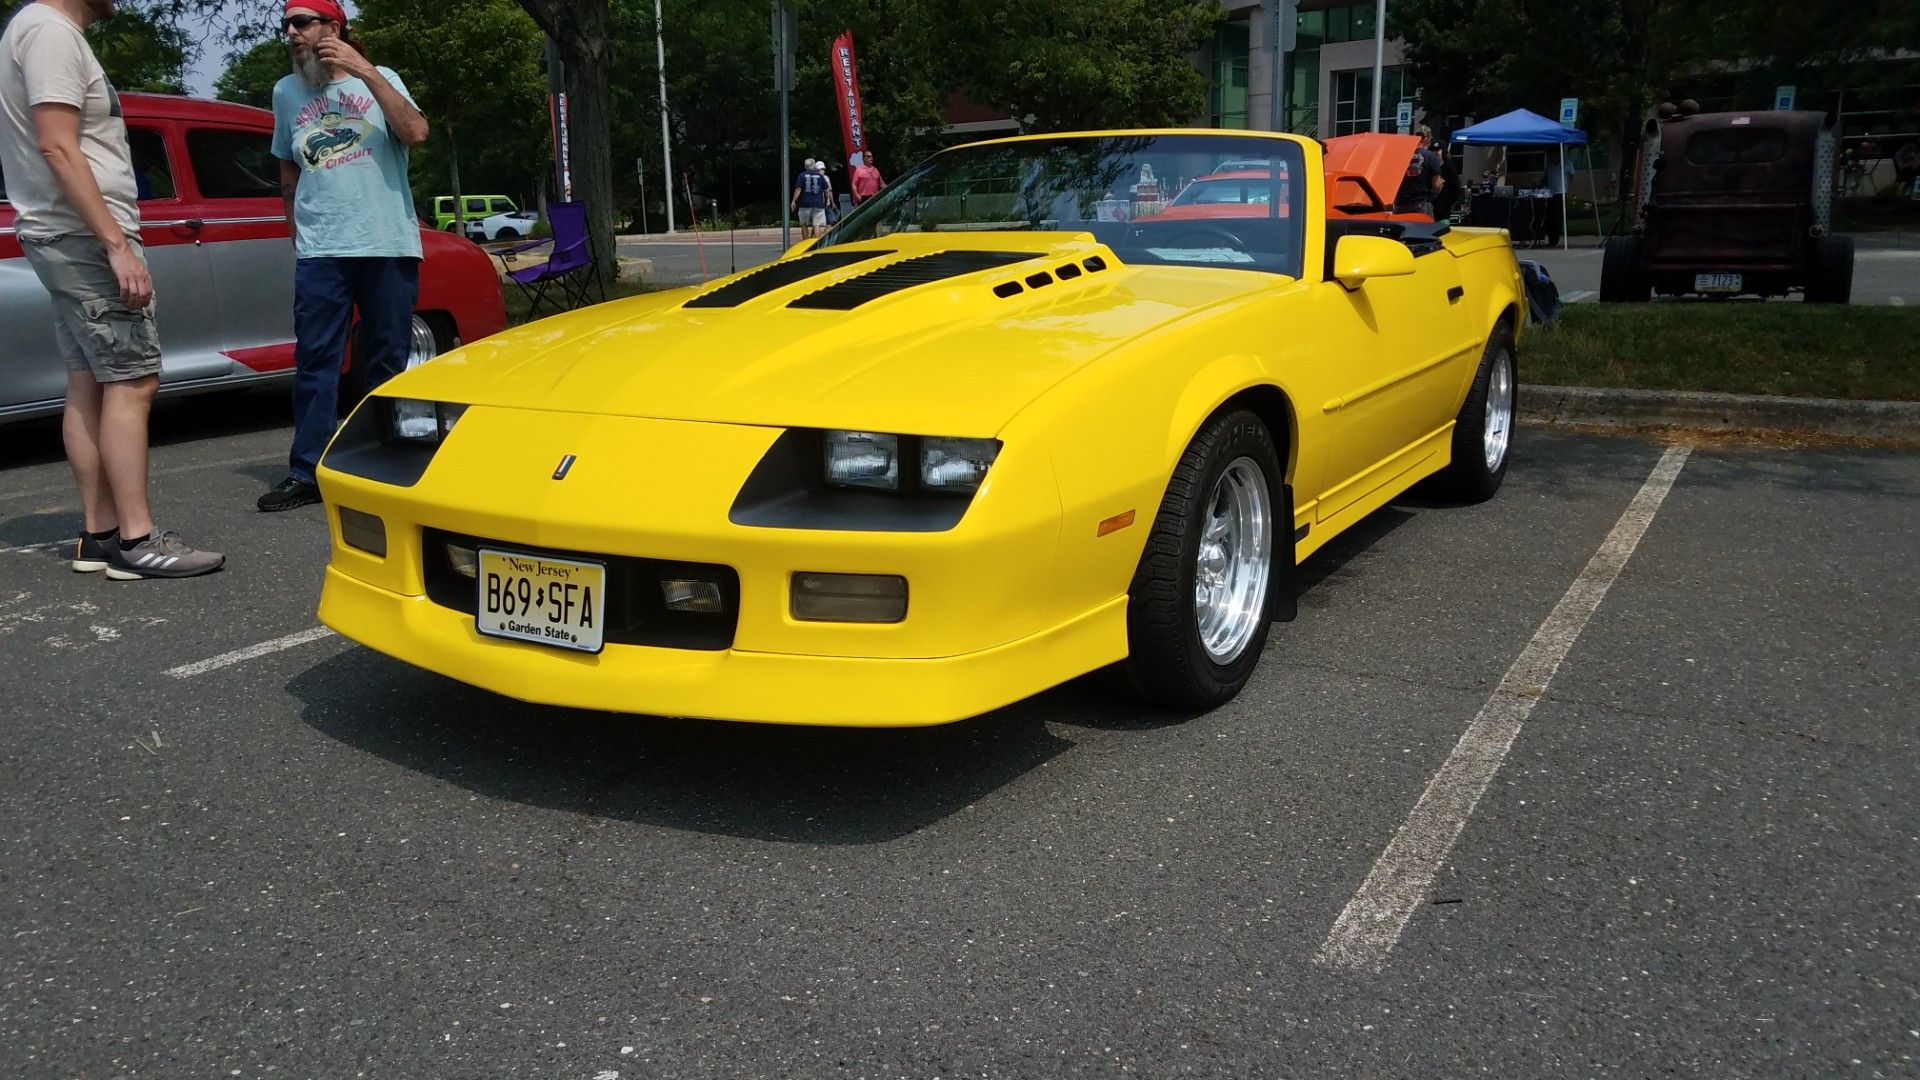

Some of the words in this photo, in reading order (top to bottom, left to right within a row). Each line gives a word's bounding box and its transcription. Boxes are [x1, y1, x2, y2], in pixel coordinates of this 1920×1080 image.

[338, 89, 375, 113] PARK
[840, 47, 861, 147] RESTAURANT
[325, 147, 374, 170] CIRCUIT
[509, 557, 535, 573] New
[536, 561, 571, 581] Jersey
[487, 572, 531, 617] B69
[548, 581, 593, 628] SFA
[508, 620, 541, 636] Garden
[544, 626, 570, 640] State
